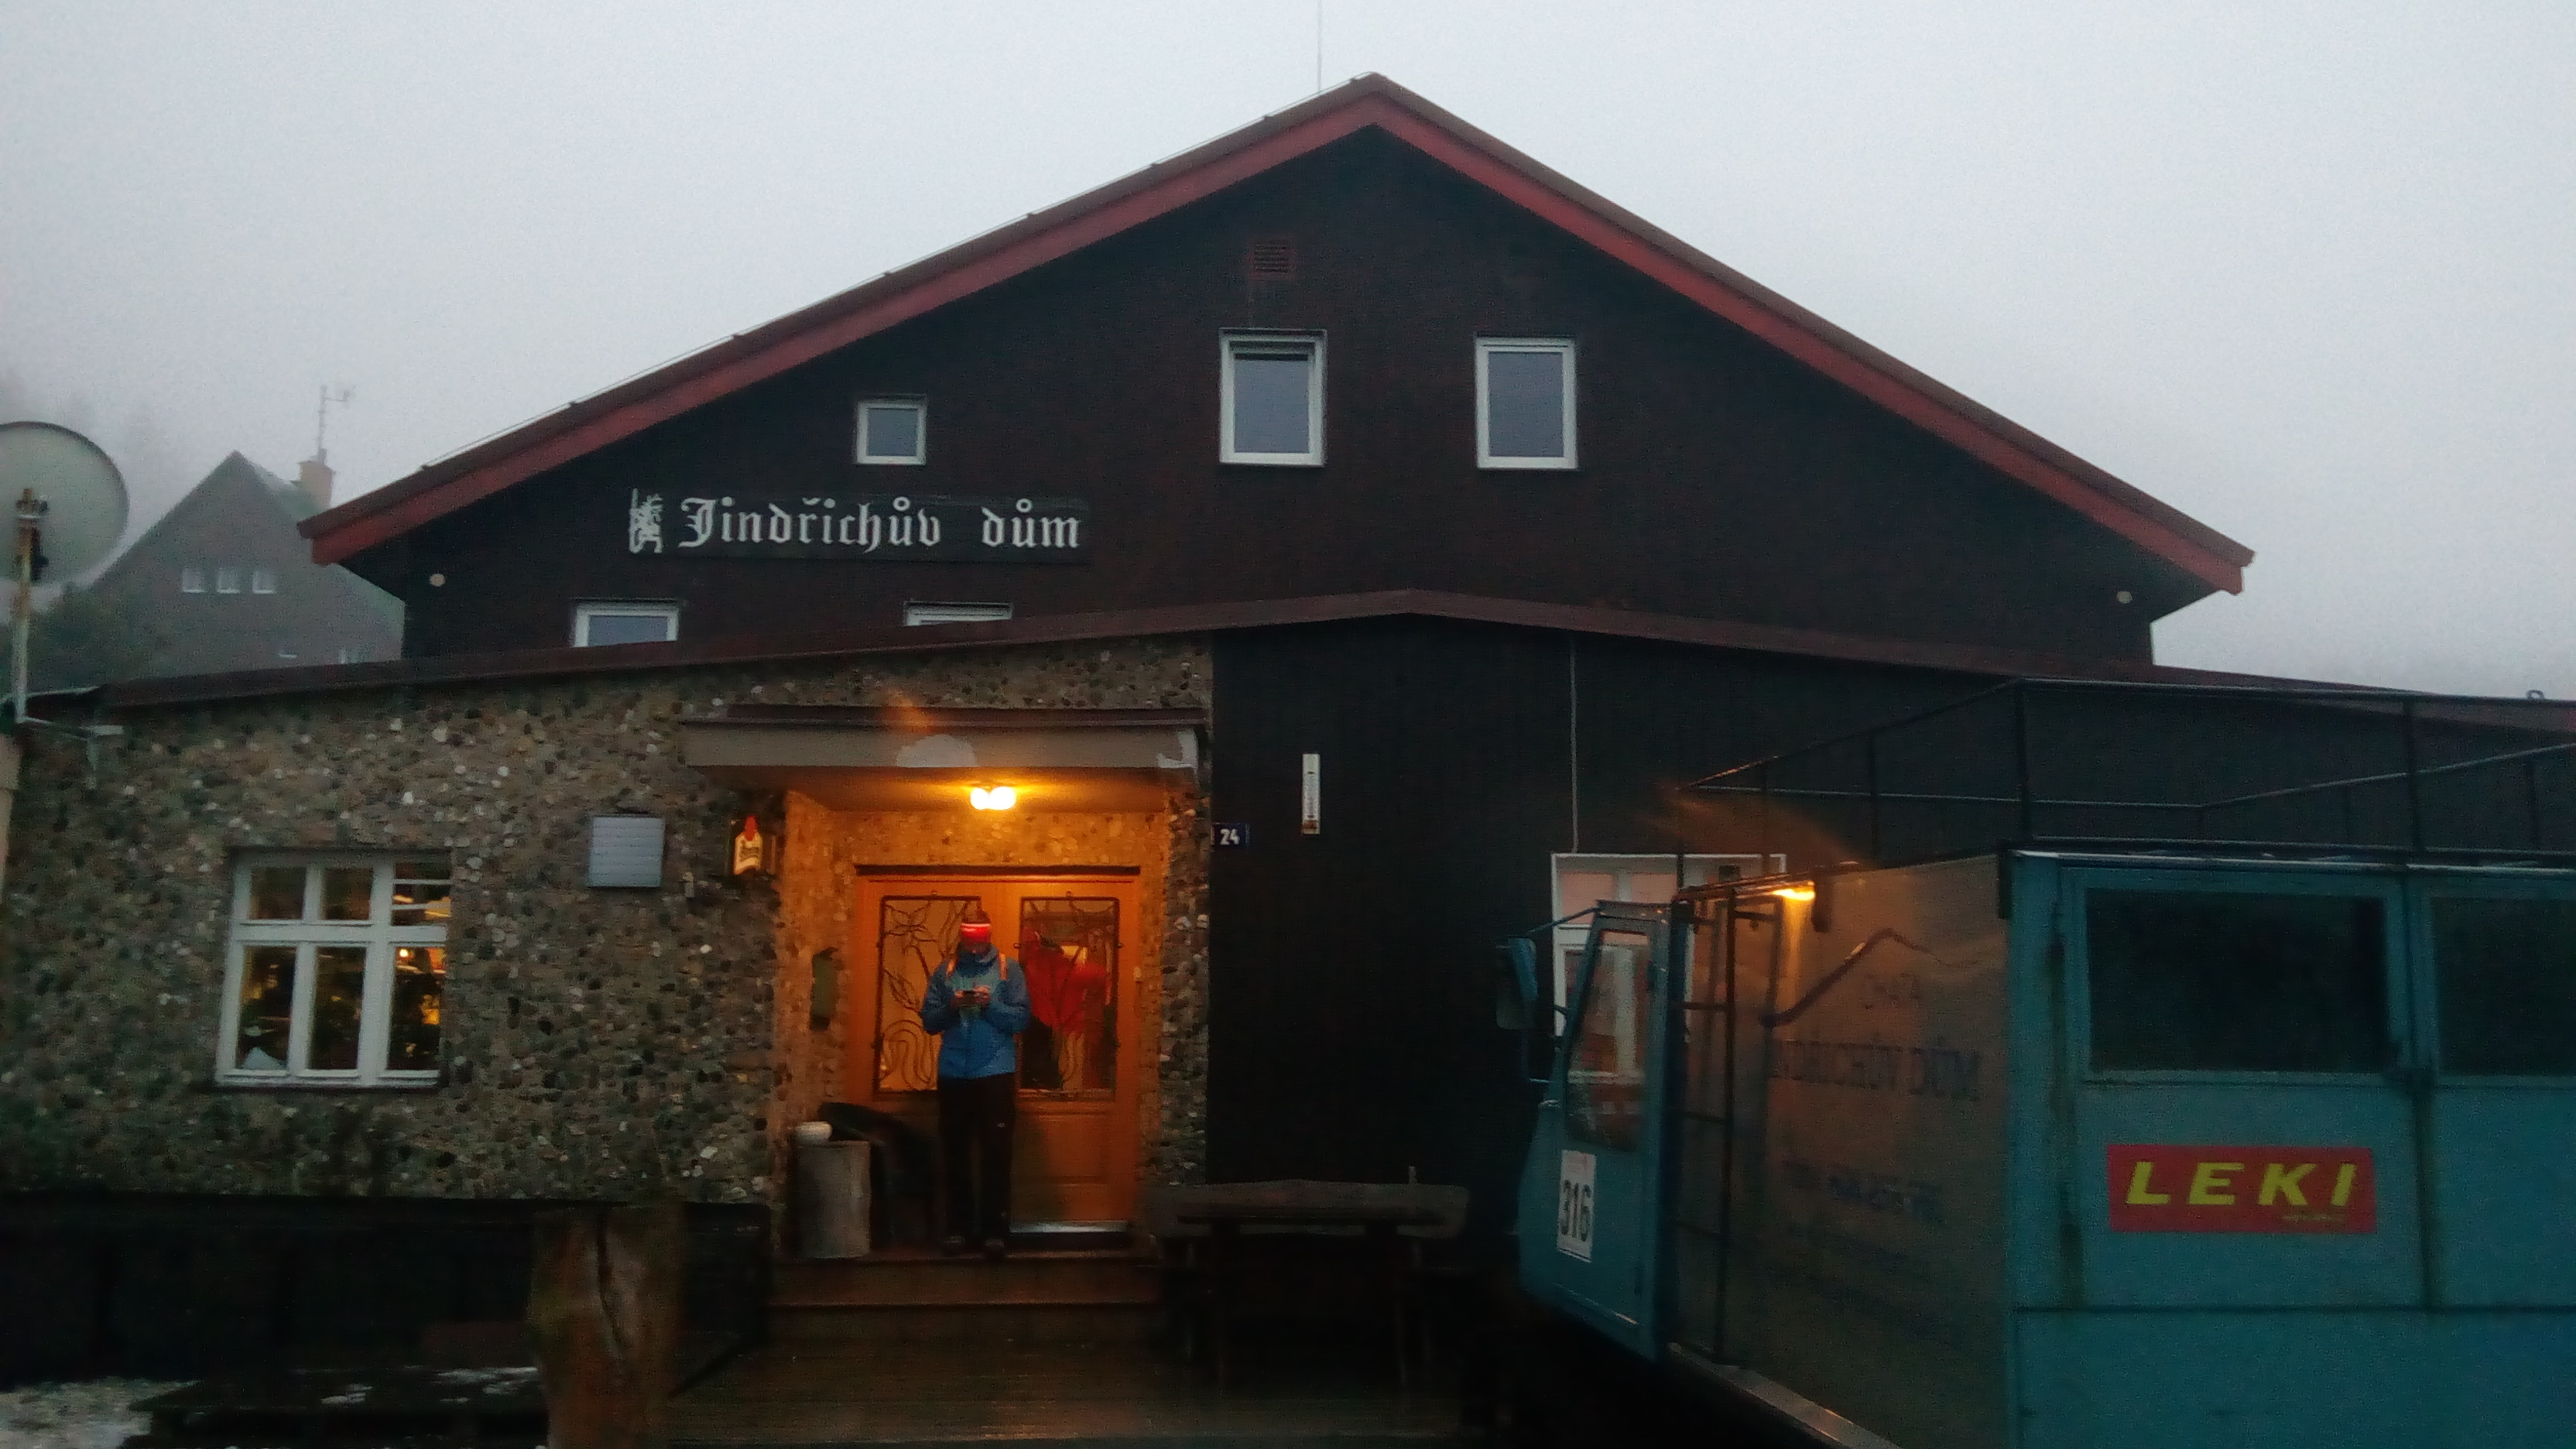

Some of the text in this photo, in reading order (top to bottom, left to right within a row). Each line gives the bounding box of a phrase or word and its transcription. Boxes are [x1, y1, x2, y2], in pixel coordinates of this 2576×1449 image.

[678, 495, 1080, 553] Jindřichův dům
[1219, 827, 1241, 846] 24
[1560, 1178, 1591, 1242] 316
[2125, 1161, 2358, 1207] LEKI
